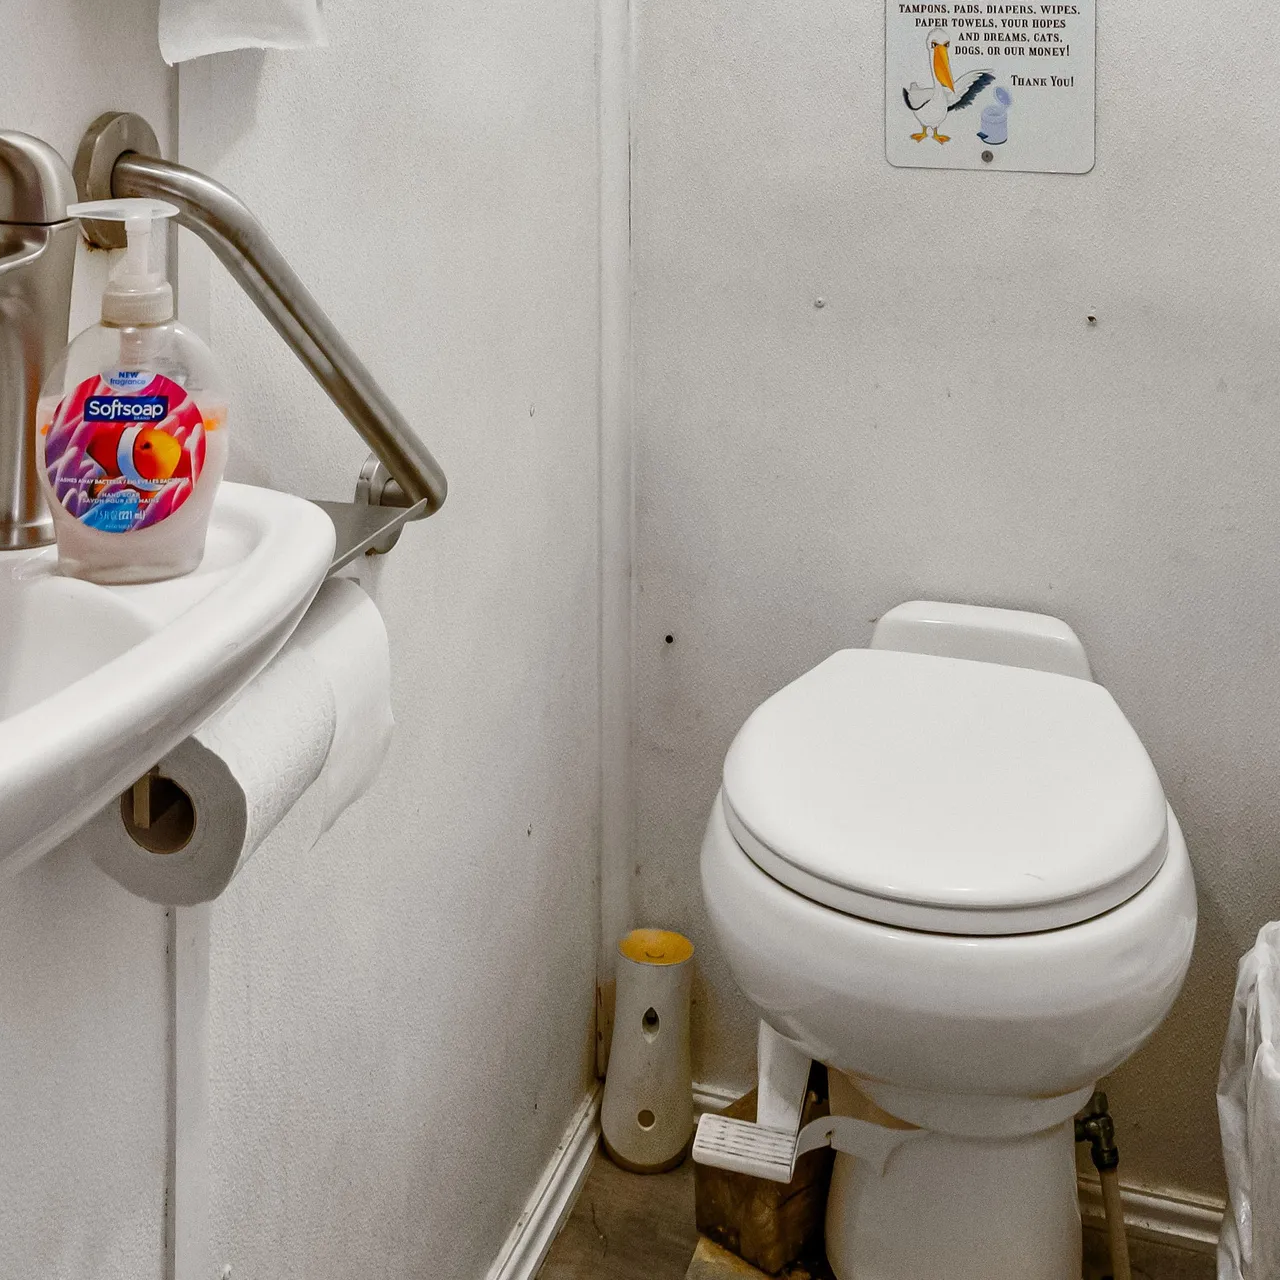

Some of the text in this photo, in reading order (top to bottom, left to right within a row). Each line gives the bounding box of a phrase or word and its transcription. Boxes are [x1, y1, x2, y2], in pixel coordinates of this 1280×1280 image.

[899, 4, 1080, 15] TAMPONS, PADS, DIAPERS, WIPES,
[915, 18, 1066, 28] PAPER TOWELS, YOUR HOPES
[958, 33, 1063, 43] AND DREAMS, CATS,
[955, 45, 1070, 57] DOGS, OR OUR MONEY!
[1011, 75, 1047, 86] THANK
[110, 378, 146, 386] fragrance
[88, 399, 164, 420] Softsoap
